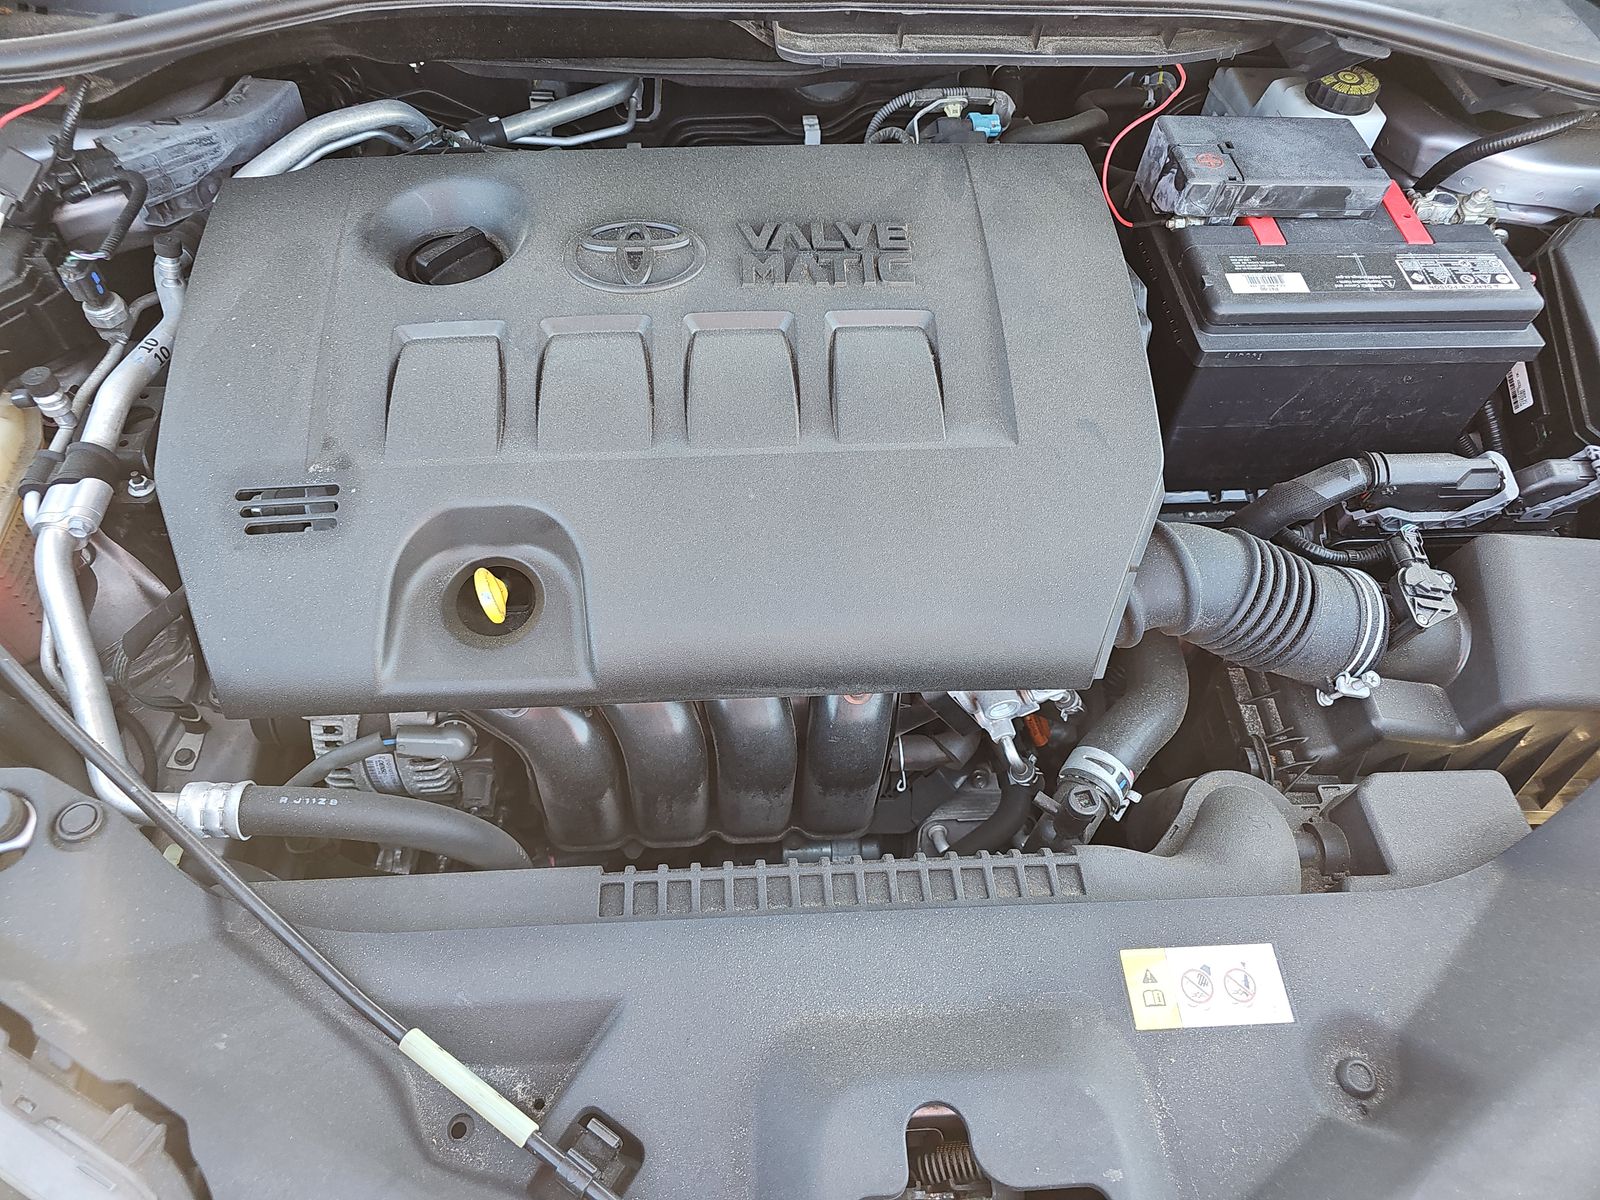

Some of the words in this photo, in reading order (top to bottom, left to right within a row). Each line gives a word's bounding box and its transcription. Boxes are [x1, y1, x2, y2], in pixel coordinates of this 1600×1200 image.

[736, 221, 911, 251] VALVE
[739, 250, 916, 286] MATIC
[138, 338, 159, 353] 10
[154, 345, 170, 366] 10
